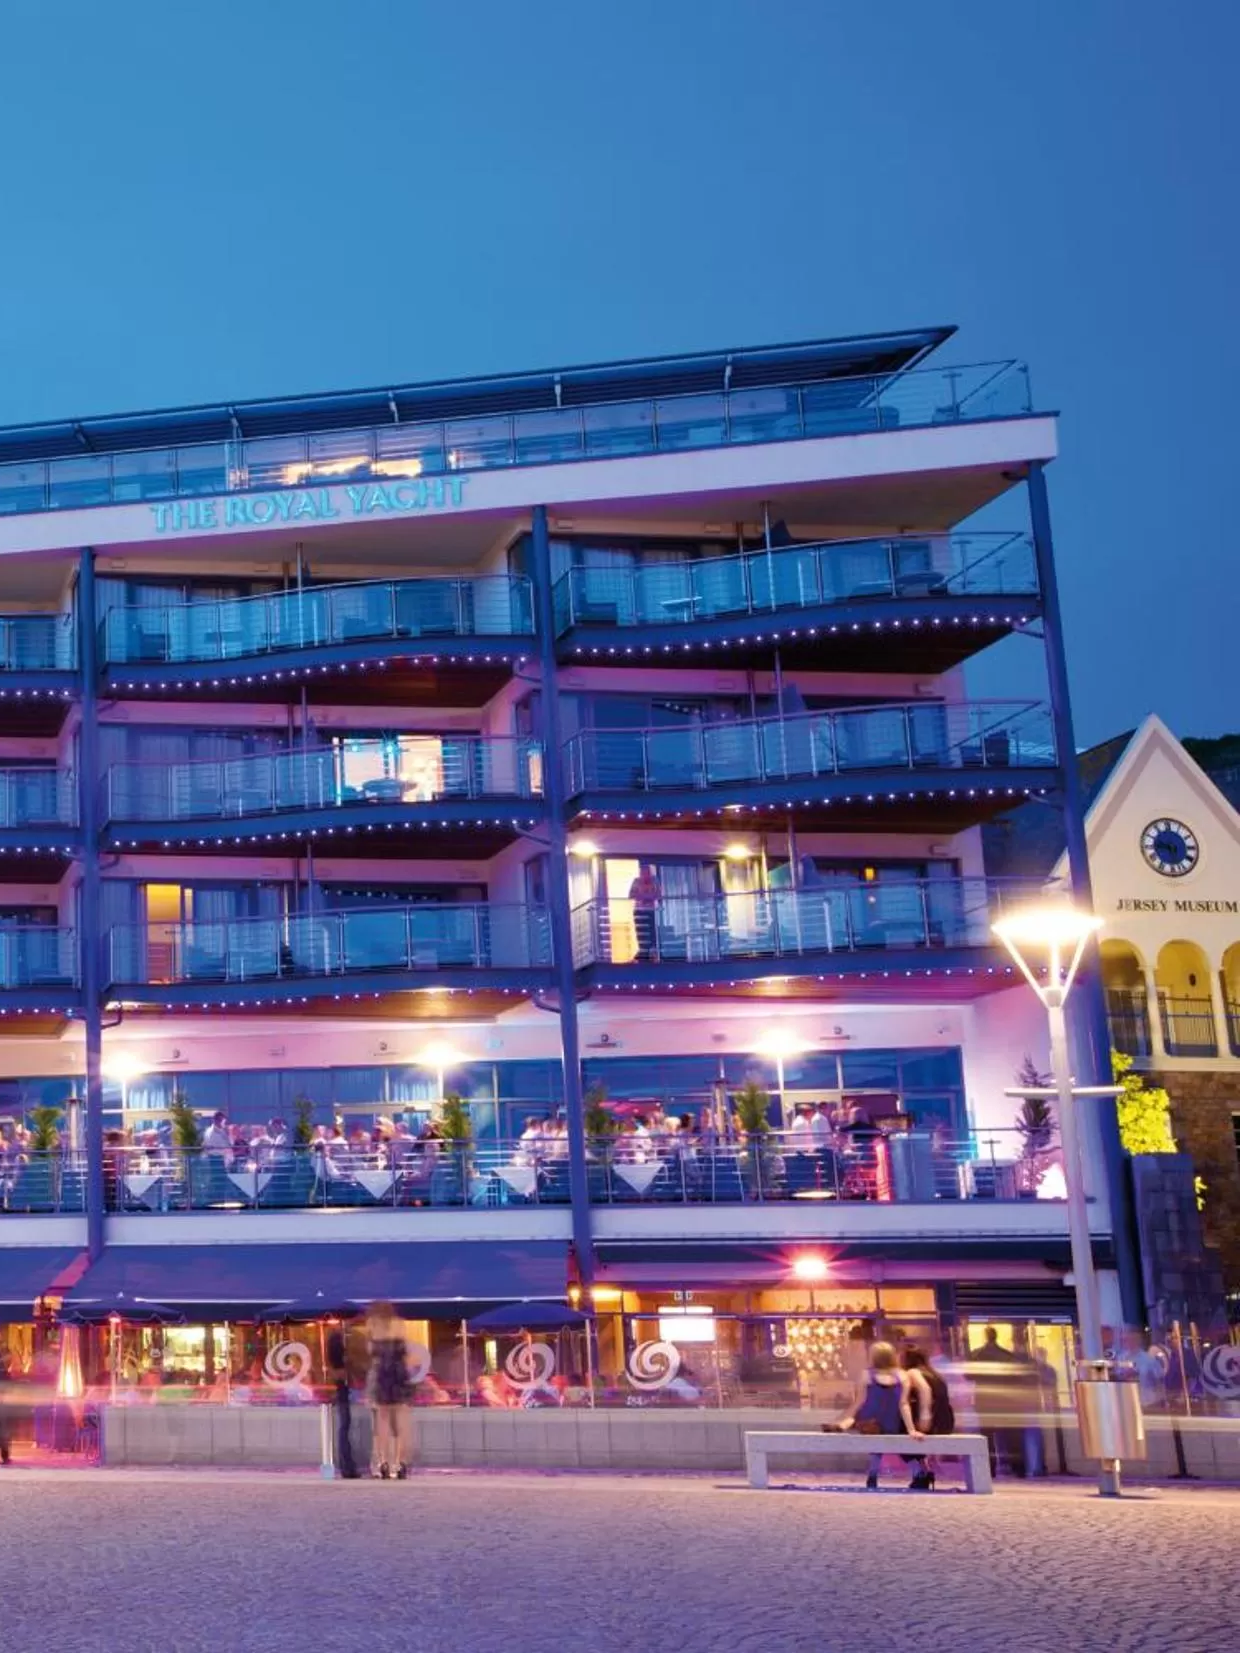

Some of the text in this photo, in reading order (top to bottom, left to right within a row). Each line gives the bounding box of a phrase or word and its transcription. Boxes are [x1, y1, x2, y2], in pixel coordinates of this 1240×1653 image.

[151, 475, 471, 533] THE ROYAL YACHT
[1116, 898, 1239, 913] JERSEY MUSEUM
